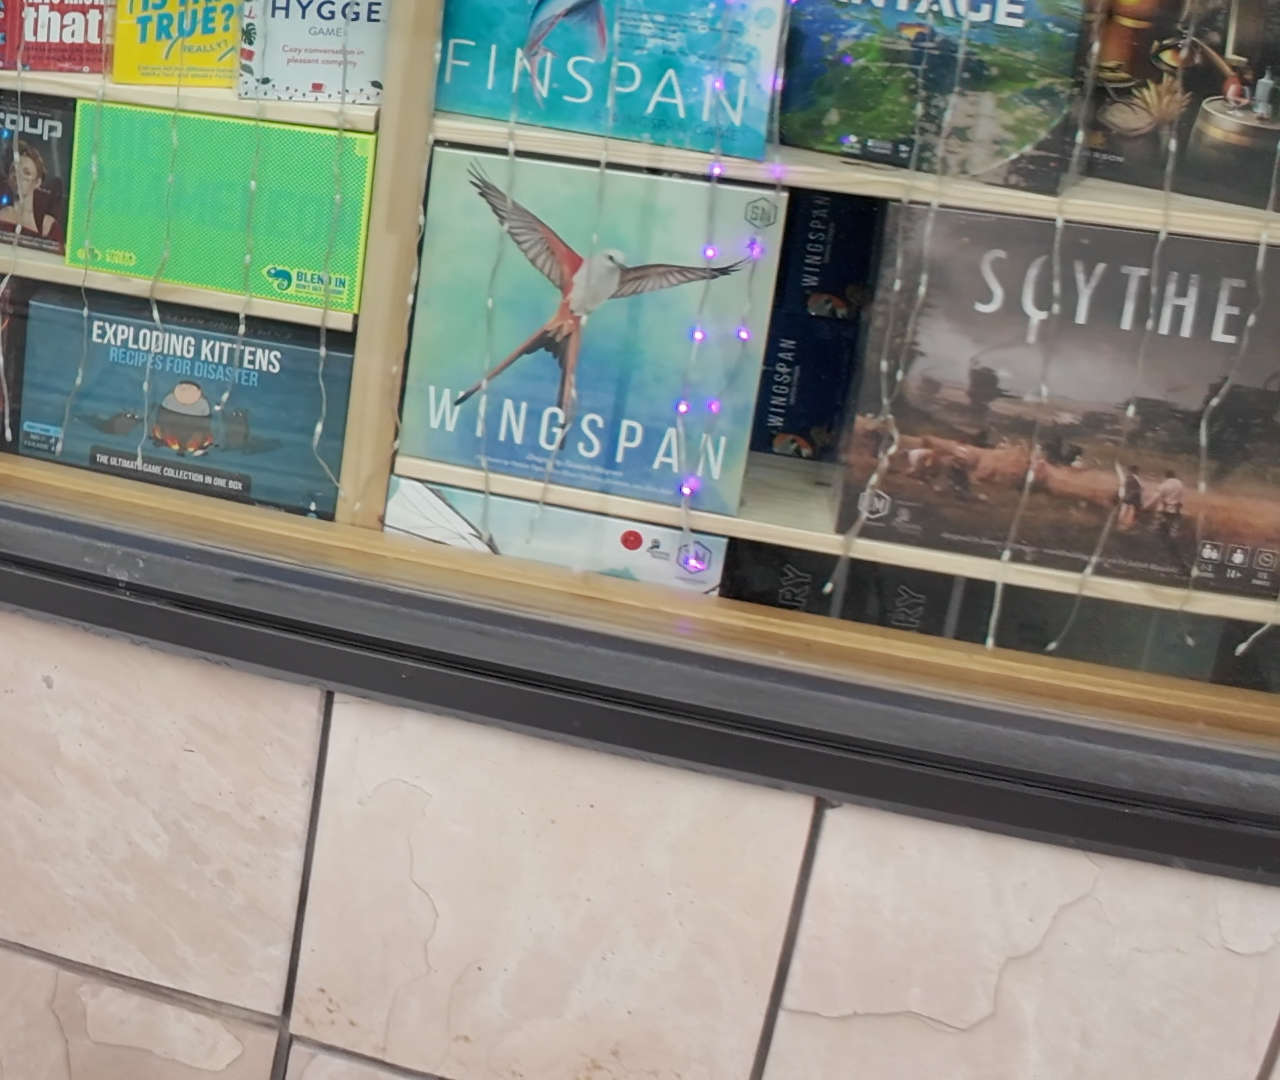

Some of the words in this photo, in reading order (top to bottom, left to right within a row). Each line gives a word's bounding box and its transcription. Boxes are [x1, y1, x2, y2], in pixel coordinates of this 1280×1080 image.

[136, 2, 236, 44] TRUE?
[308, 26, 343, 37] GAME
[182, 39, 228, 53] REALLY?
[281, 44, 302, 55] Cozy
[286, 56, 320, 66] pleasant
[444, 38, 747, 127] FINSPAN
[800, 195, 832, 288] WINGSPAN
[335, 274, 347, 288] IN
[973, 248, 1248, 344] SCYTHE
[91, 320, 196, 358] EXPLODING
[200, 340, 282, 374] KITTENS
[108, 347, 164, 371] RECIPES
[165, 353, 192, 375] FOR
[767, 337, 798, 428] WINGSPAN
[427, 384, 728, 481] WINGSPAN
[95, 453, 110, 464] THE
[110, 456, 141, 470] ULTIMAT
[142, 462, 162, 476] GAME
[162, 466, 204, 483] COLLECTION
[204, 475, 213, 485] IN
[213, 477, 228, 488] ONE
[228, 480, 243, 490] BOX
